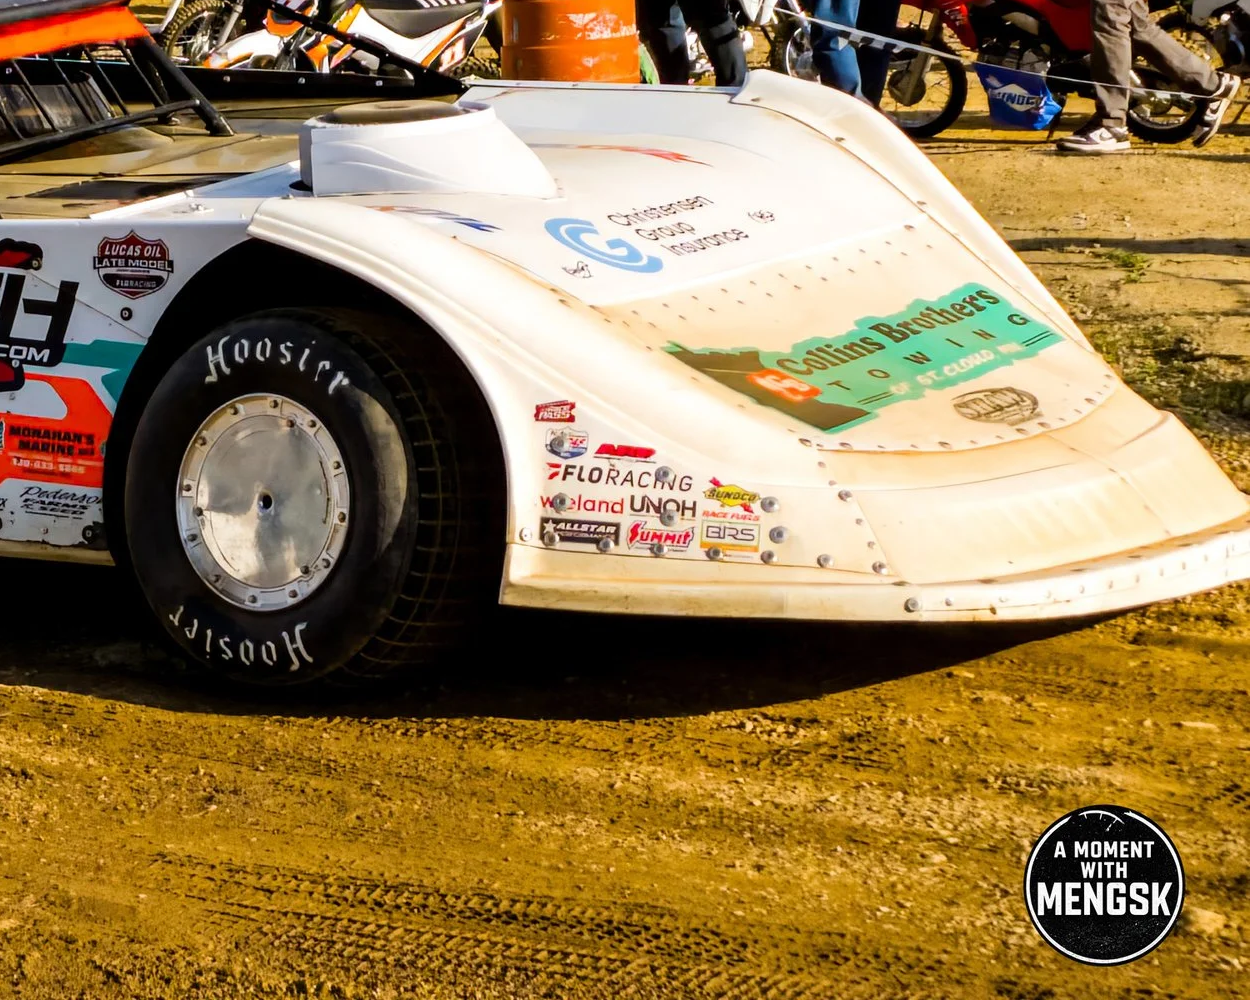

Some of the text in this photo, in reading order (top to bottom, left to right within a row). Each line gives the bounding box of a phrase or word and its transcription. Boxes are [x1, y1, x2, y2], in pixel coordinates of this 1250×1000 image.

[607, 195, 714, 227] Christensen
[635, 221, 696, 241] Group
[104, 243, 162, 258] LUCAS OIL
[661, 228, 749, 257] Insurance
[95, 257, 126, 268] LATE
[128, 259, 172, 271] MODEL
[776, 288, 1000, 376] Collins Brothers
[18, 439, 75, 457] MARINE
[540, 493, 624, 515] weland
[707, 487, 758, 503] SUNOCO
[22, 498, 91, 511] FARMS
[629, 494, 697, 518] UNOH
[702, 509, 760, 521] RACE FUELS
[556, 521, 617, 533] ALLSTAR
